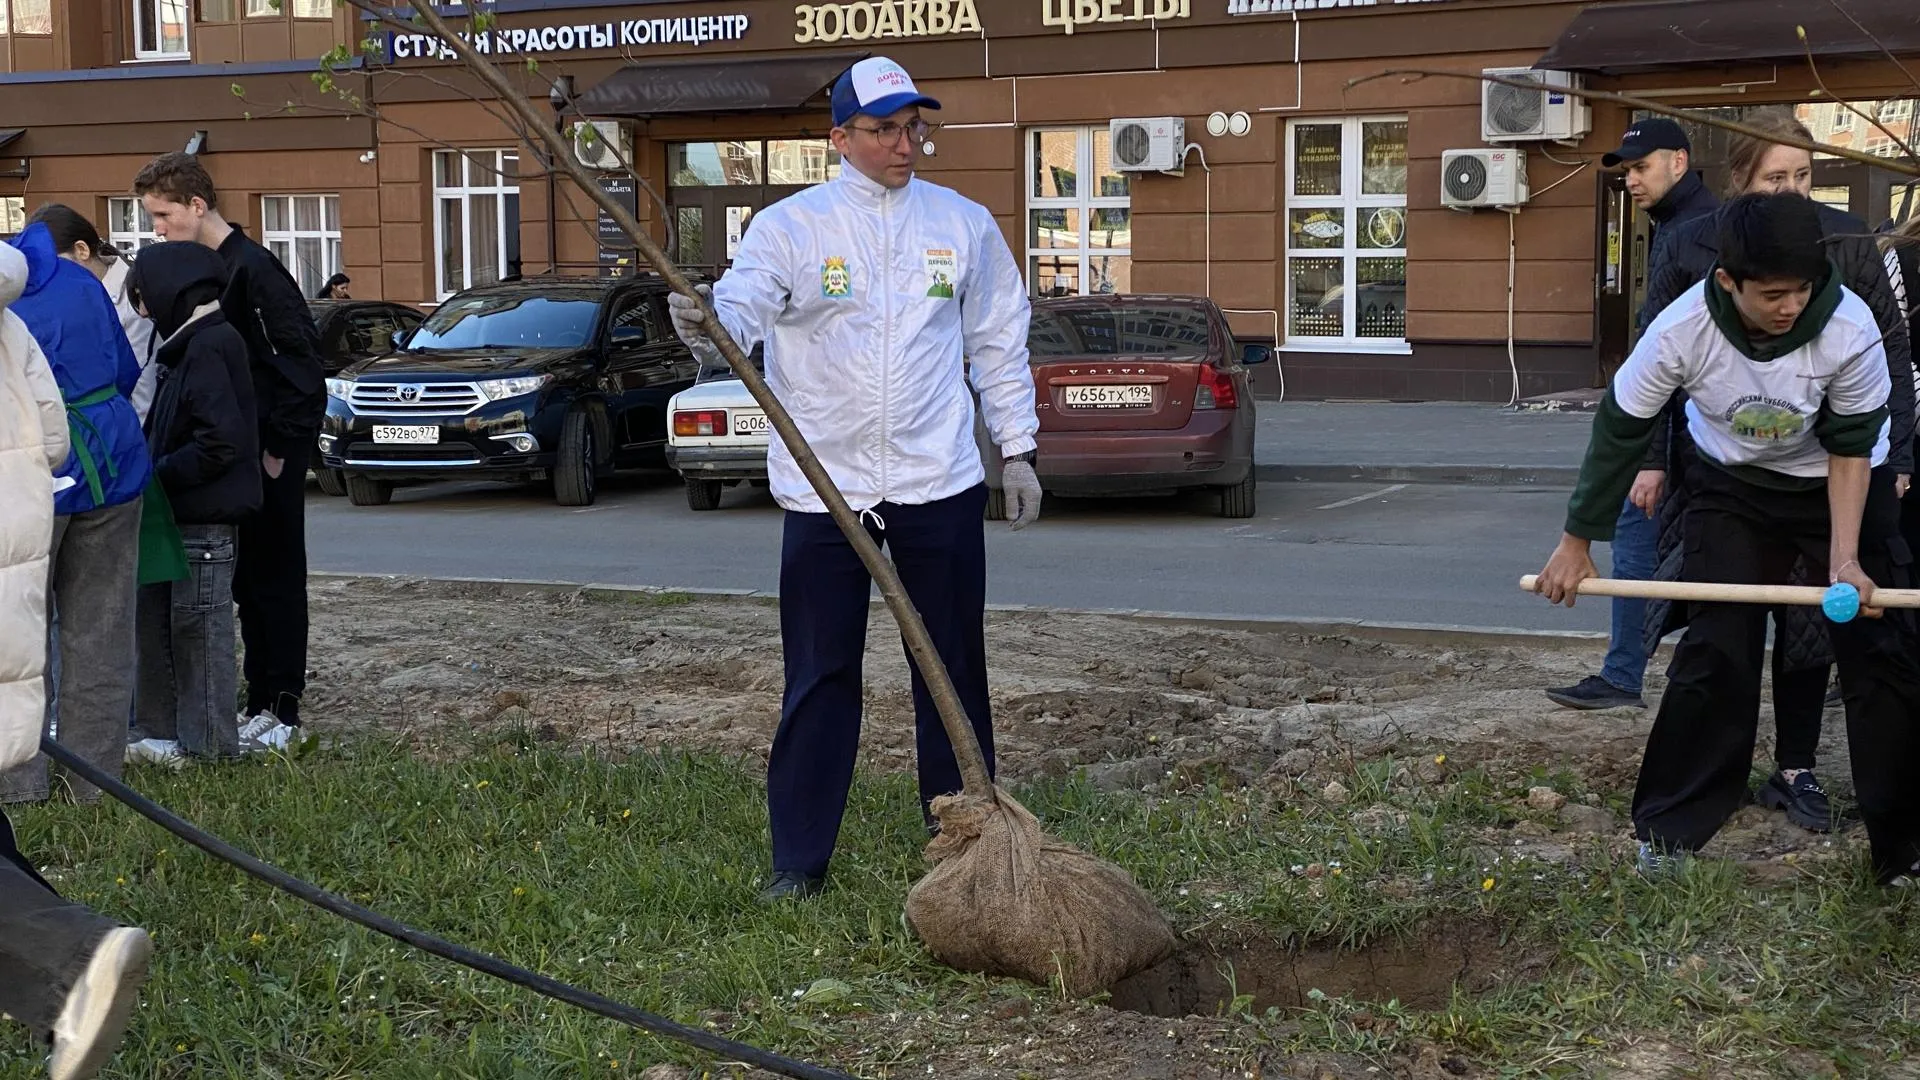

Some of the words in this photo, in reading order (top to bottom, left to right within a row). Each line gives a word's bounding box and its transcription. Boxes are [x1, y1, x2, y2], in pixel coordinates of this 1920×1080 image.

[497, 27, 614, 53] КРАСОТЫ
[620, 14, 748, 46] КОПИЦЕНТР
[795, 0, 981, 42] ЗООАКВА
[740, 417, 770, 430] О06
